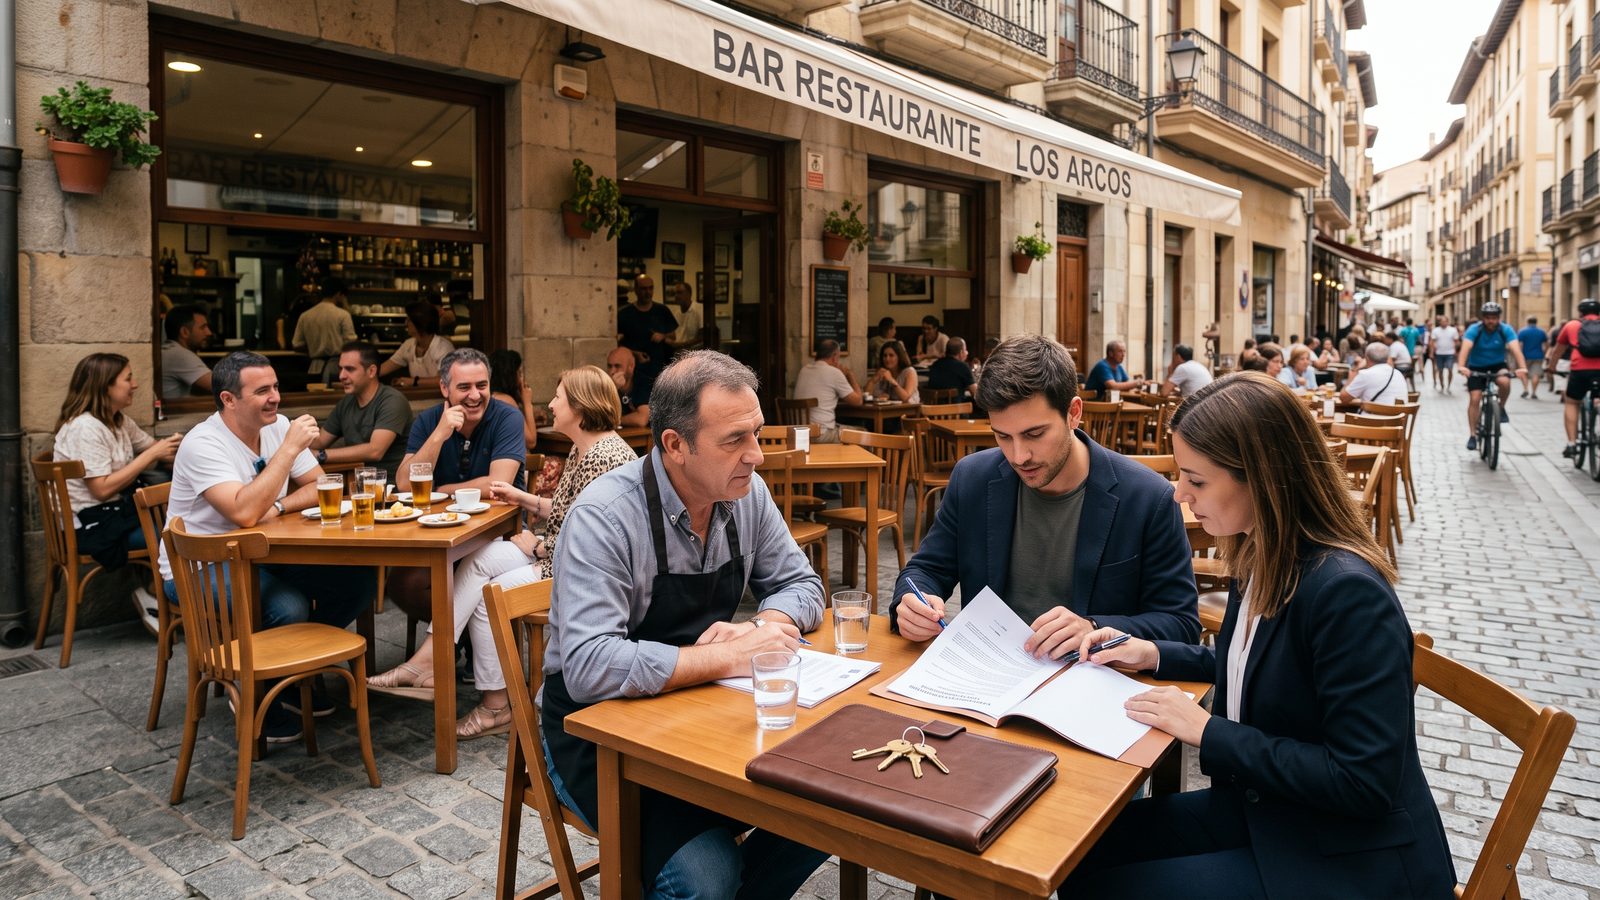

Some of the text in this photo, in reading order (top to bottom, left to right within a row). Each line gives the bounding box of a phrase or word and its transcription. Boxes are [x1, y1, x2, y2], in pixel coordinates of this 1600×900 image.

[713, 28, 1132, 198] BAR RESTAURANTE LOS ARCOS
[167, 151, 230, 182] BAR
